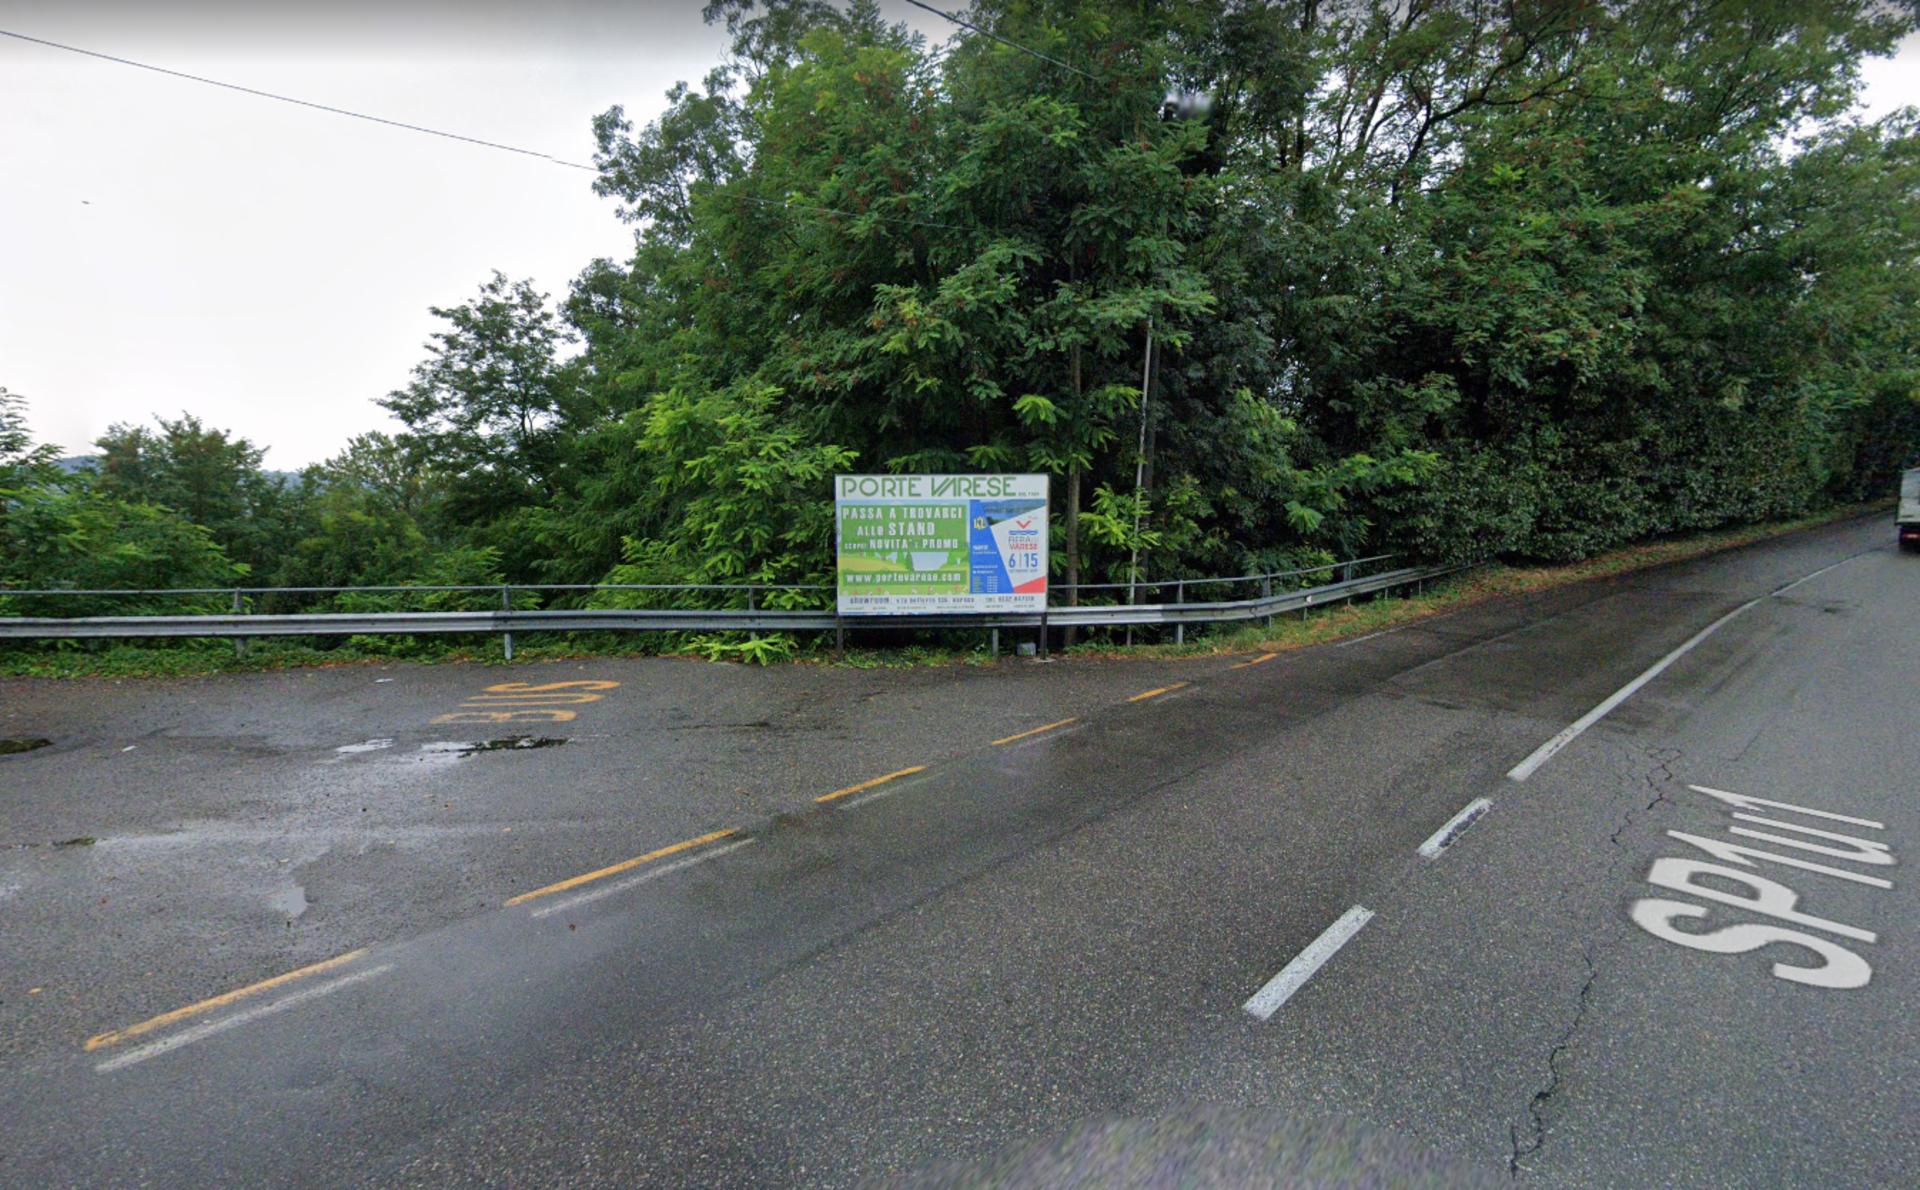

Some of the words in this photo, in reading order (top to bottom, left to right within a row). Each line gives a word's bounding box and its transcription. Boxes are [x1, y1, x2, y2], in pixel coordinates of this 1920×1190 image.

[841, 477, 922, 497] PORTE
[931, 477, 1017, 497] VARESE
[842, 507, 883, 519] PASSA
[889, 507, 897, 519] A
[903, 506, 963, 519] TROVARCI
[857, 526, 884, 536] ALLO
[888, 522, 935, 536] STAND
[922, 539, 958, 549] PROMO
